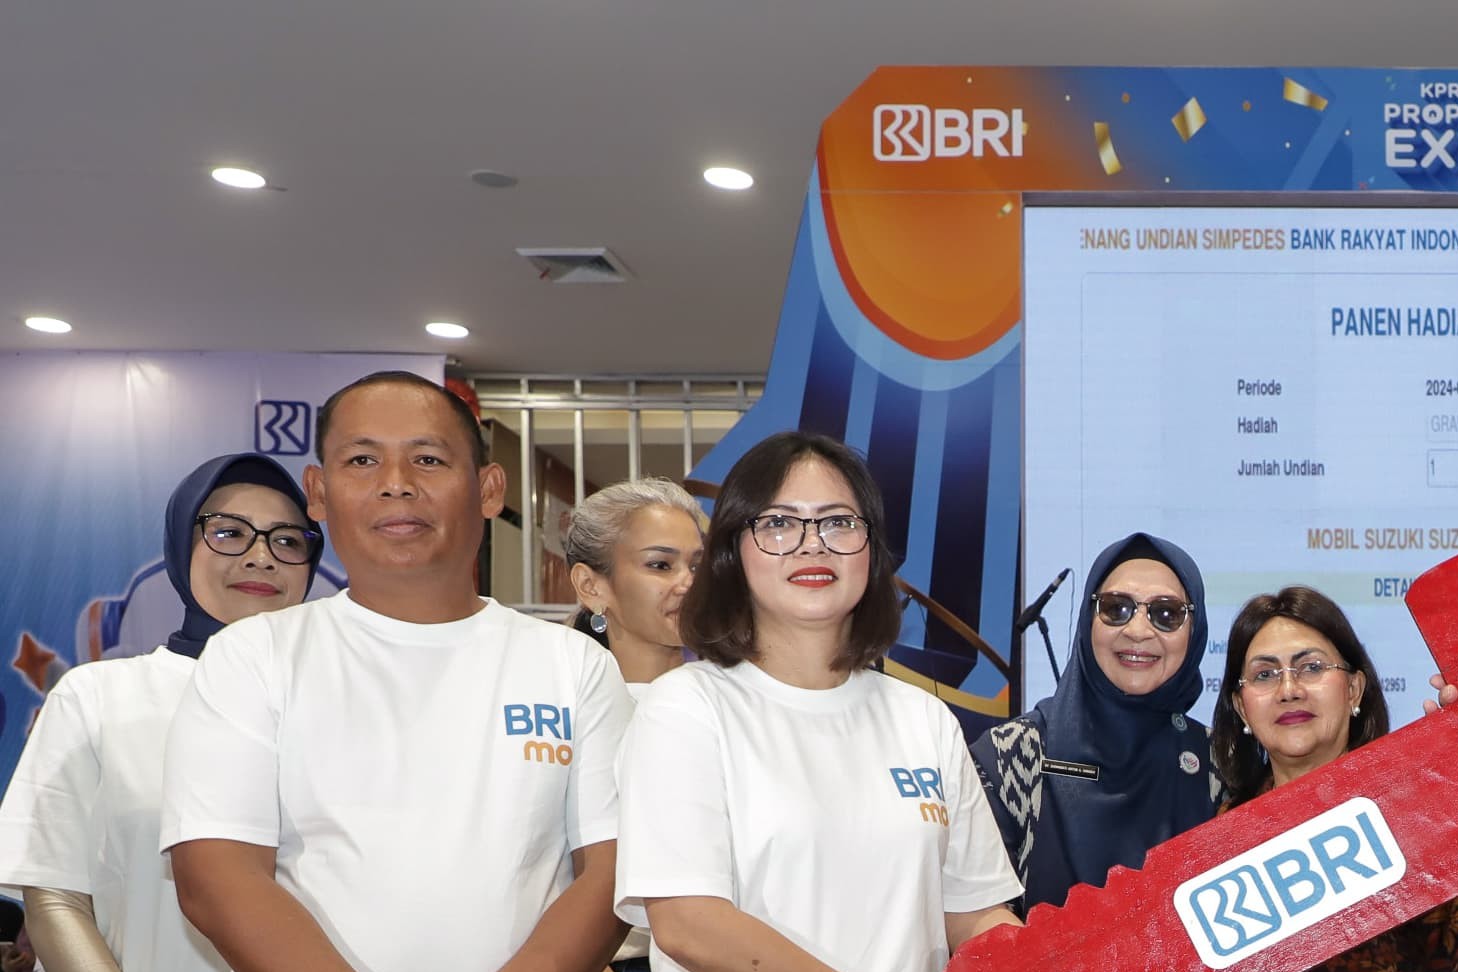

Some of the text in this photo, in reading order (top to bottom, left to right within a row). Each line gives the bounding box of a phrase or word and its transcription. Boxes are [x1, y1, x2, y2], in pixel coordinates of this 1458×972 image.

[934, 108, 1024, 157] BRI
[1136, 228, 1198, 249] UNDIAN
[1202, 228, 1285, 250] SIMPEDES
[1290, 228, 1335, 250] BANK
[1341, 229, 1406, 250] RAKYAT
[1331, 307, 1400, 336] PANEN
[1237, 379, 1282, 396] Periode
[1237, 416, 1278, 433] Hadiah
[1237, 459, 1280, 476] Jumlah
[1283, 459, 1325, 476] Undian
[1307, 528, 1358, 549] MOBIL
[1364, 528, 1424, 549] SUZUKI
[1374, 577, 1413, 597] DETA
[504, 703, 572, 741] BRI
[524, 740, 573, 766] mo
[889, 767, 945, 802] BRI
[920, 802, 949, 827] mo
[1263, 811, 1393, 917] BRI
